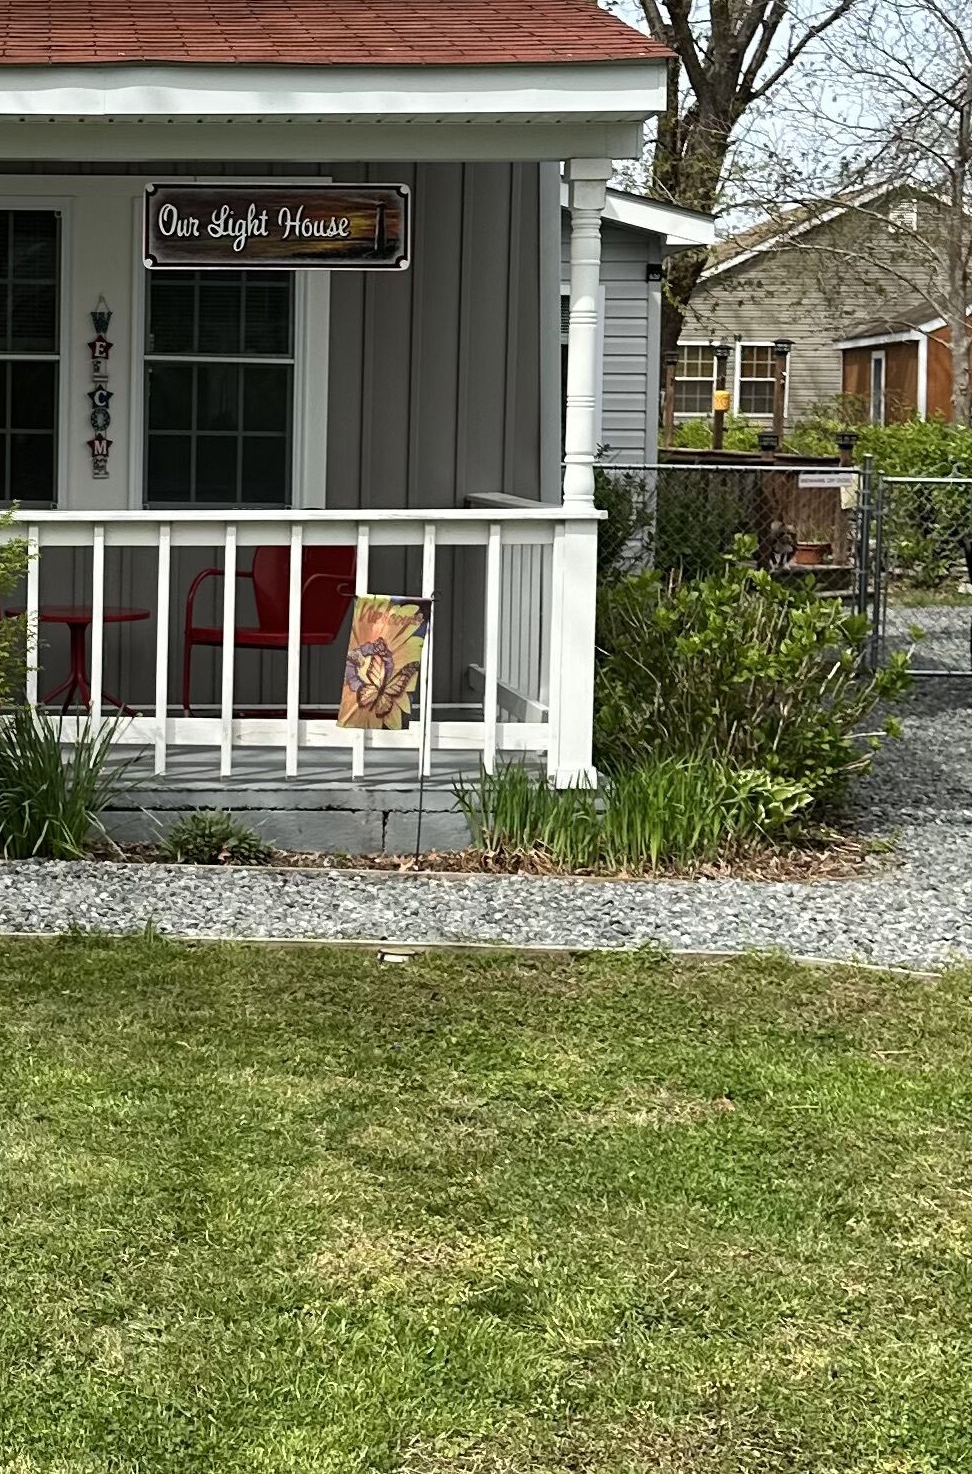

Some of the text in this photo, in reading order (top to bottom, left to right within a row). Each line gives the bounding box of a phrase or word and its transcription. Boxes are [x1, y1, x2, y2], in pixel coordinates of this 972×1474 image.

[158, 203, 351, 252] Our Light House
